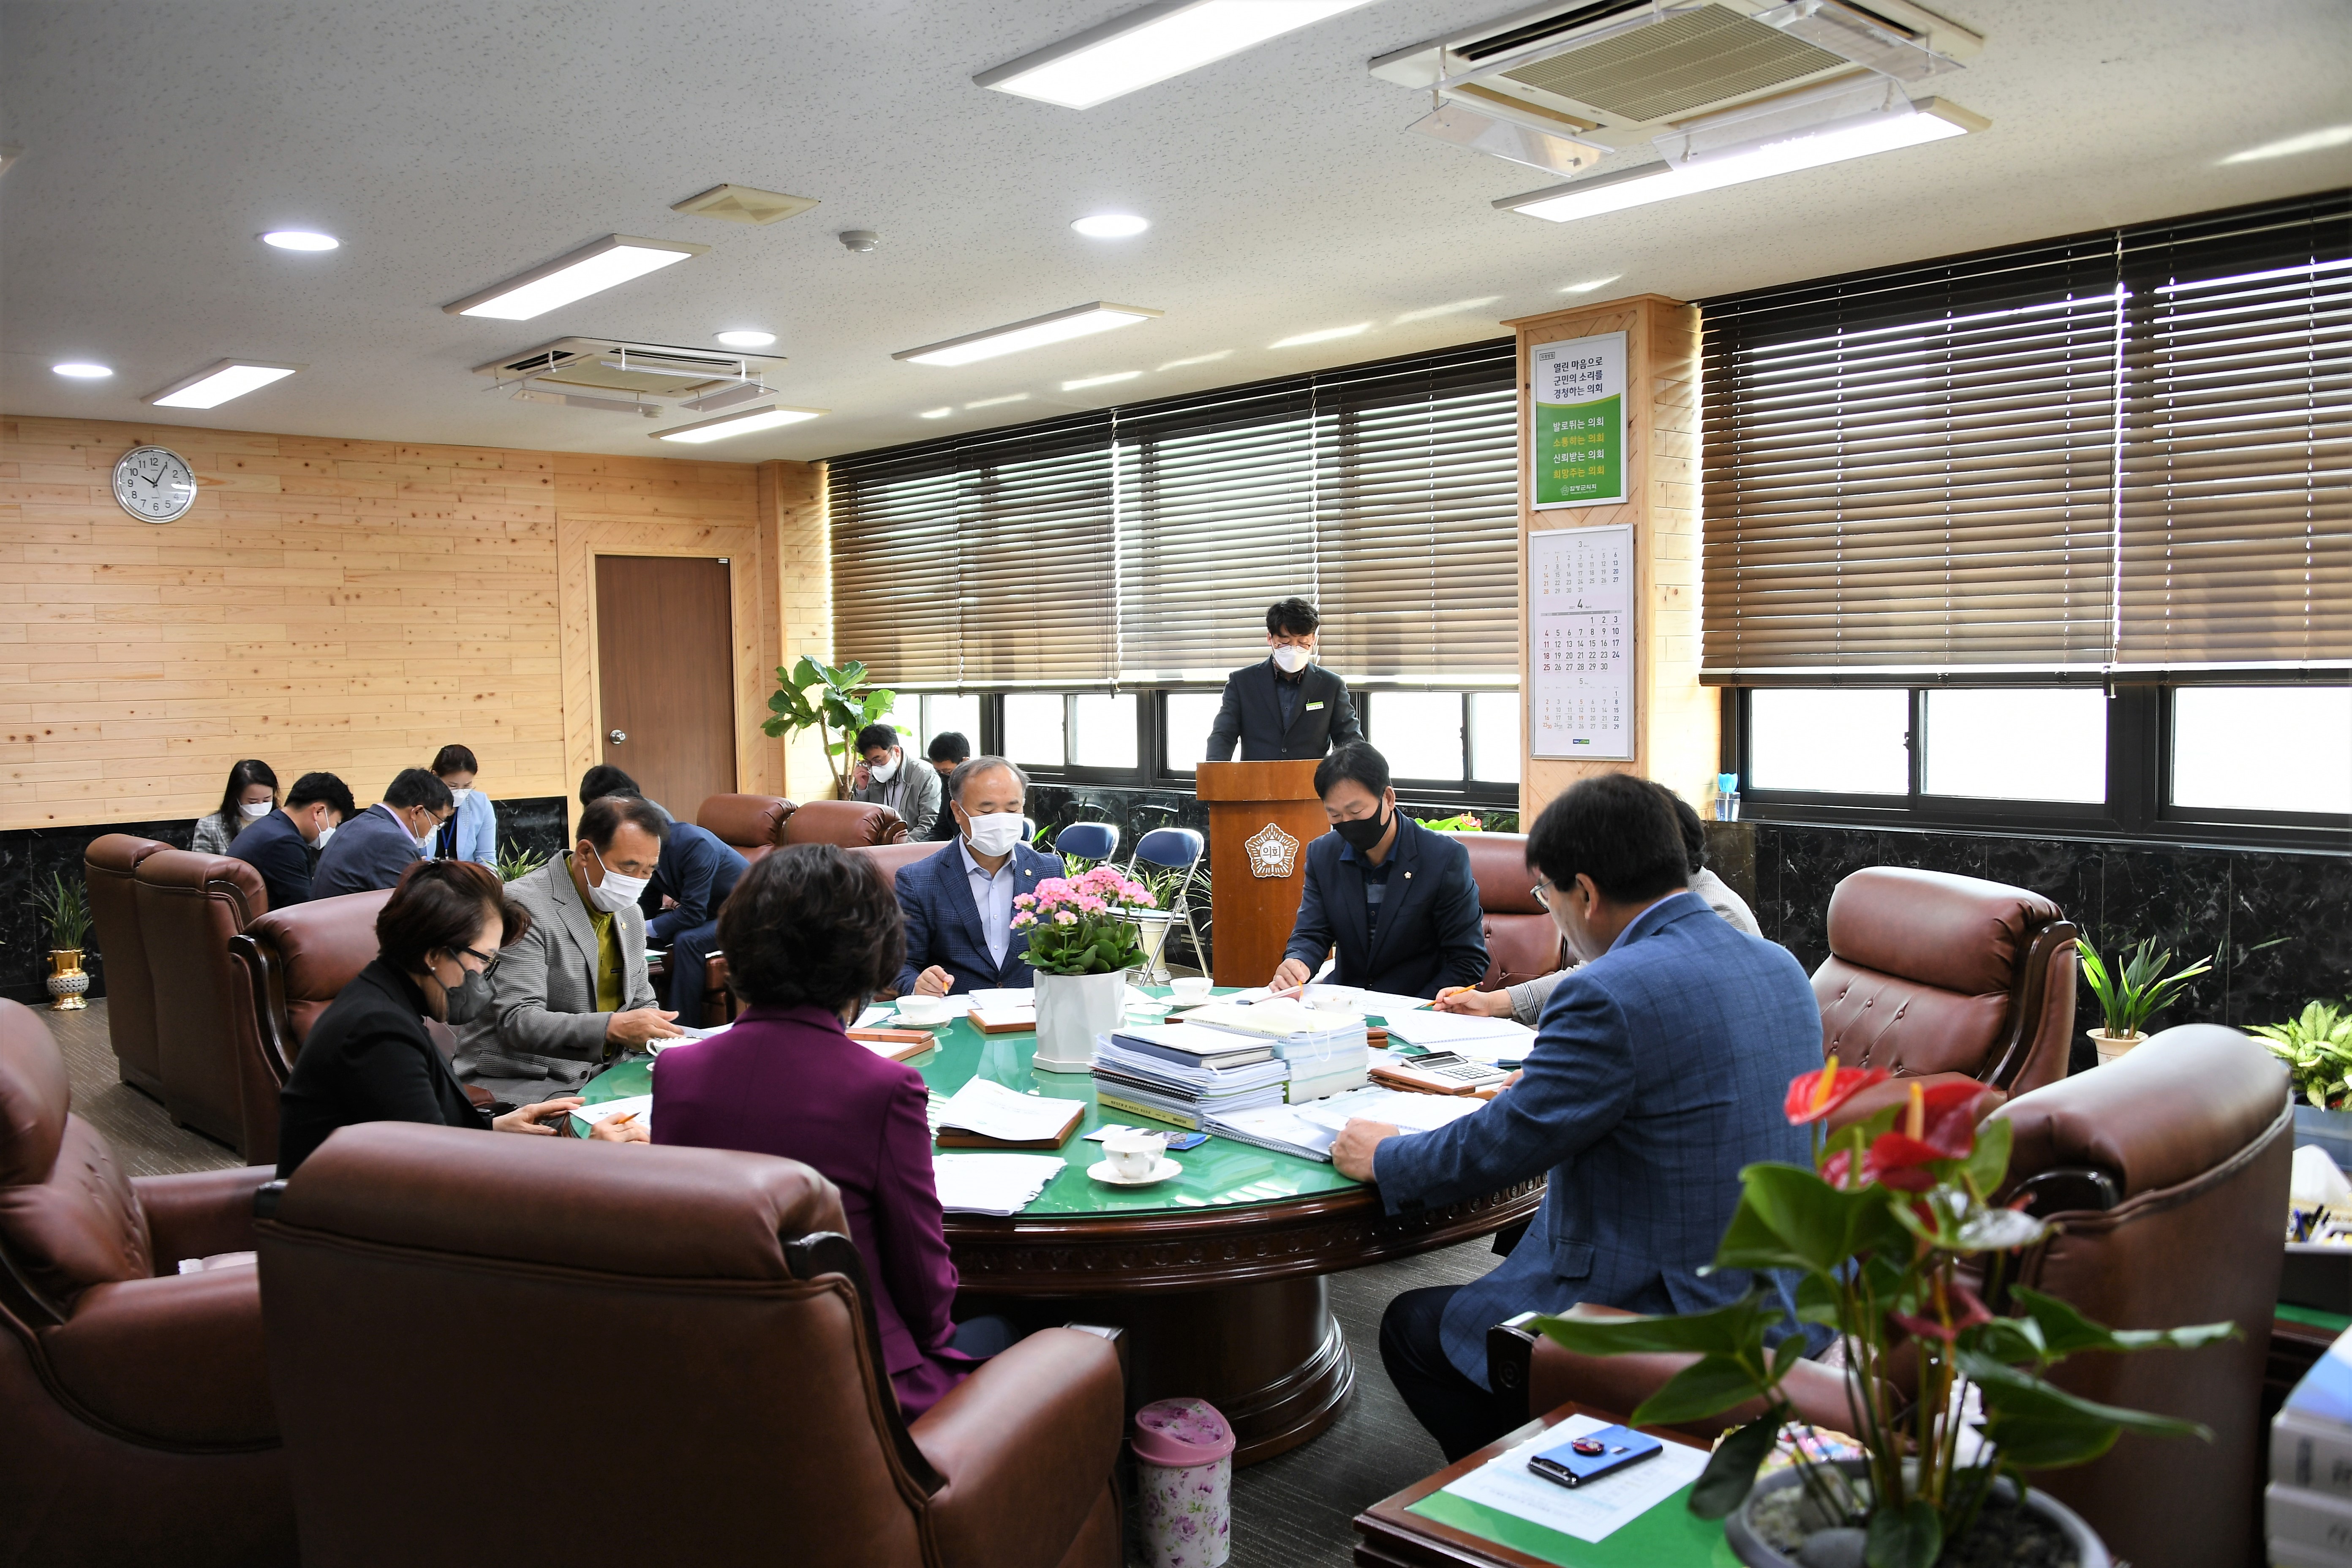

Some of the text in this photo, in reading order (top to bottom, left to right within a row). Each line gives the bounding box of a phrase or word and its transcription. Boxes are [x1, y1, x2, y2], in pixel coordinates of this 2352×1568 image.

[1554, 357, 1603, 373] 열린 마음으로
[1554, 370, 1603, 386] 군민의 소리를
[1554, 383, 1603, 399] 경청하는 의회
[1553, 416, 1604, 432] 발로뛰는 의회
[1553, 433, 1604, 447] 소통하는 의회
[150, 458, 158, 466] 12
[1553, 449, 1604, 463] 신뢰받는 의회
[130, 468, 138, 476] 10
[173, 470, 178, 478] 2
[1553, 465, 1604, 479] 희망주는 의회
[1578, 599, 1583, 608] 4
[1263, 846, 1281, 858] 의회
